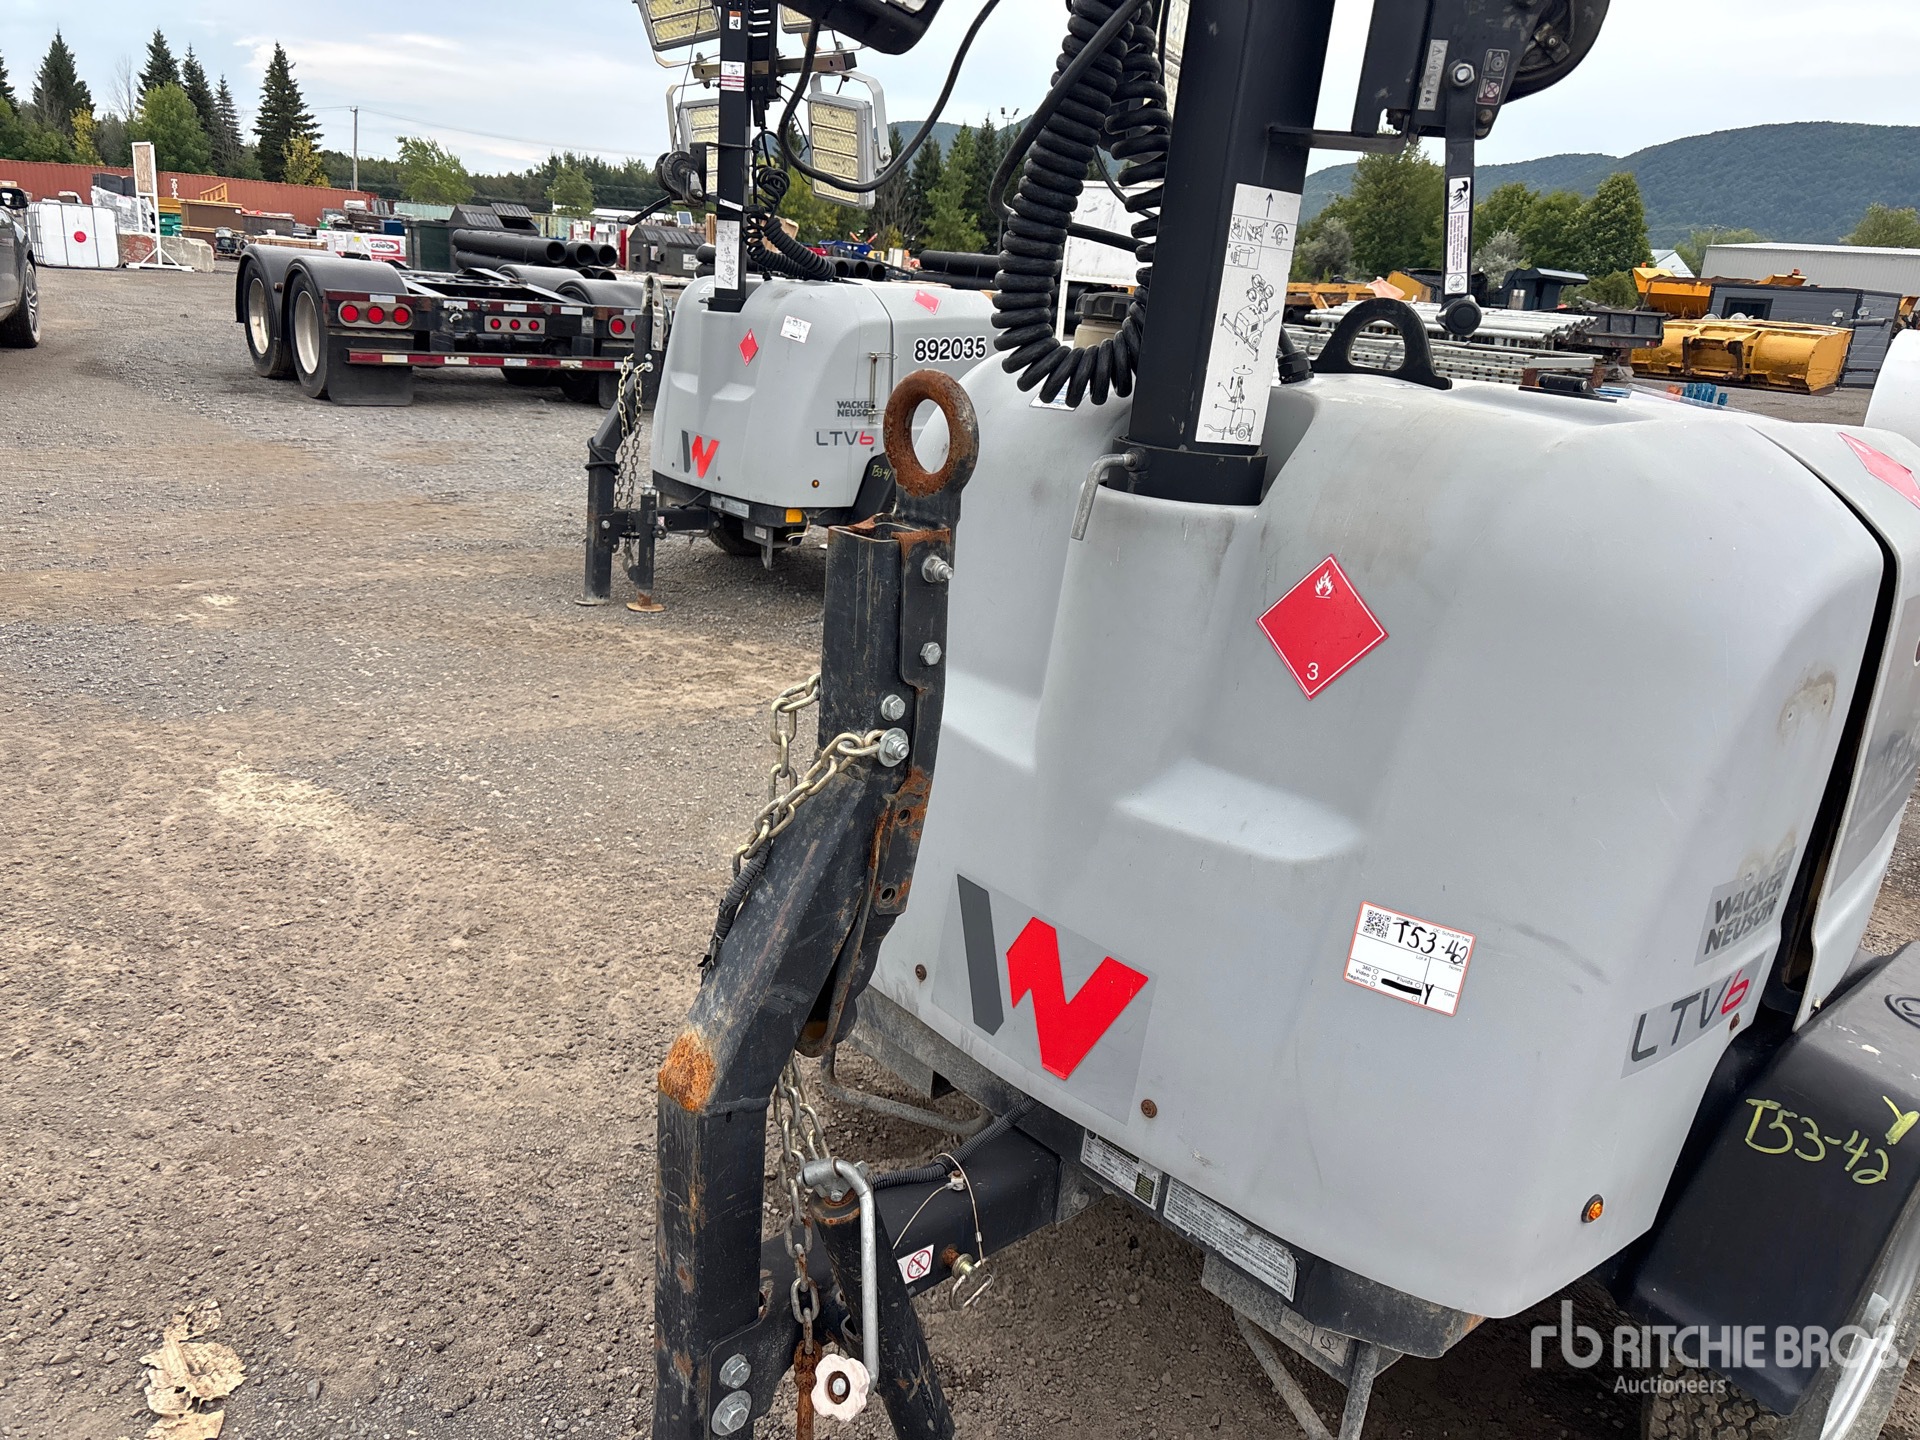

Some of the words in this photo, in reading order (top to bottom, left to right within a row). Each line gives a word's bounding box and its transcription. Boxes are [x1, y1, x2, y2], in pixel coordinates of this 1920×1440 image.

[914, 336, 987, 363] 892035
[837, 401, 869, 409] WACKE
[837, 409, 869, 417] NEUSO
[816, 431, 875, 446] LTV6
[1306, 662, 1319, 681] 3
[1715, 872, 1783, 924] WACKER
[1704, 898, 1778, 955] NEUSON
[1355, 968, 1370, 977] Video
[1396, 976, 1414, 985] Fluids
[1630, 969, 1750, 1062] LTV6
[1744, 1098, 1891, 1186] T53-42
